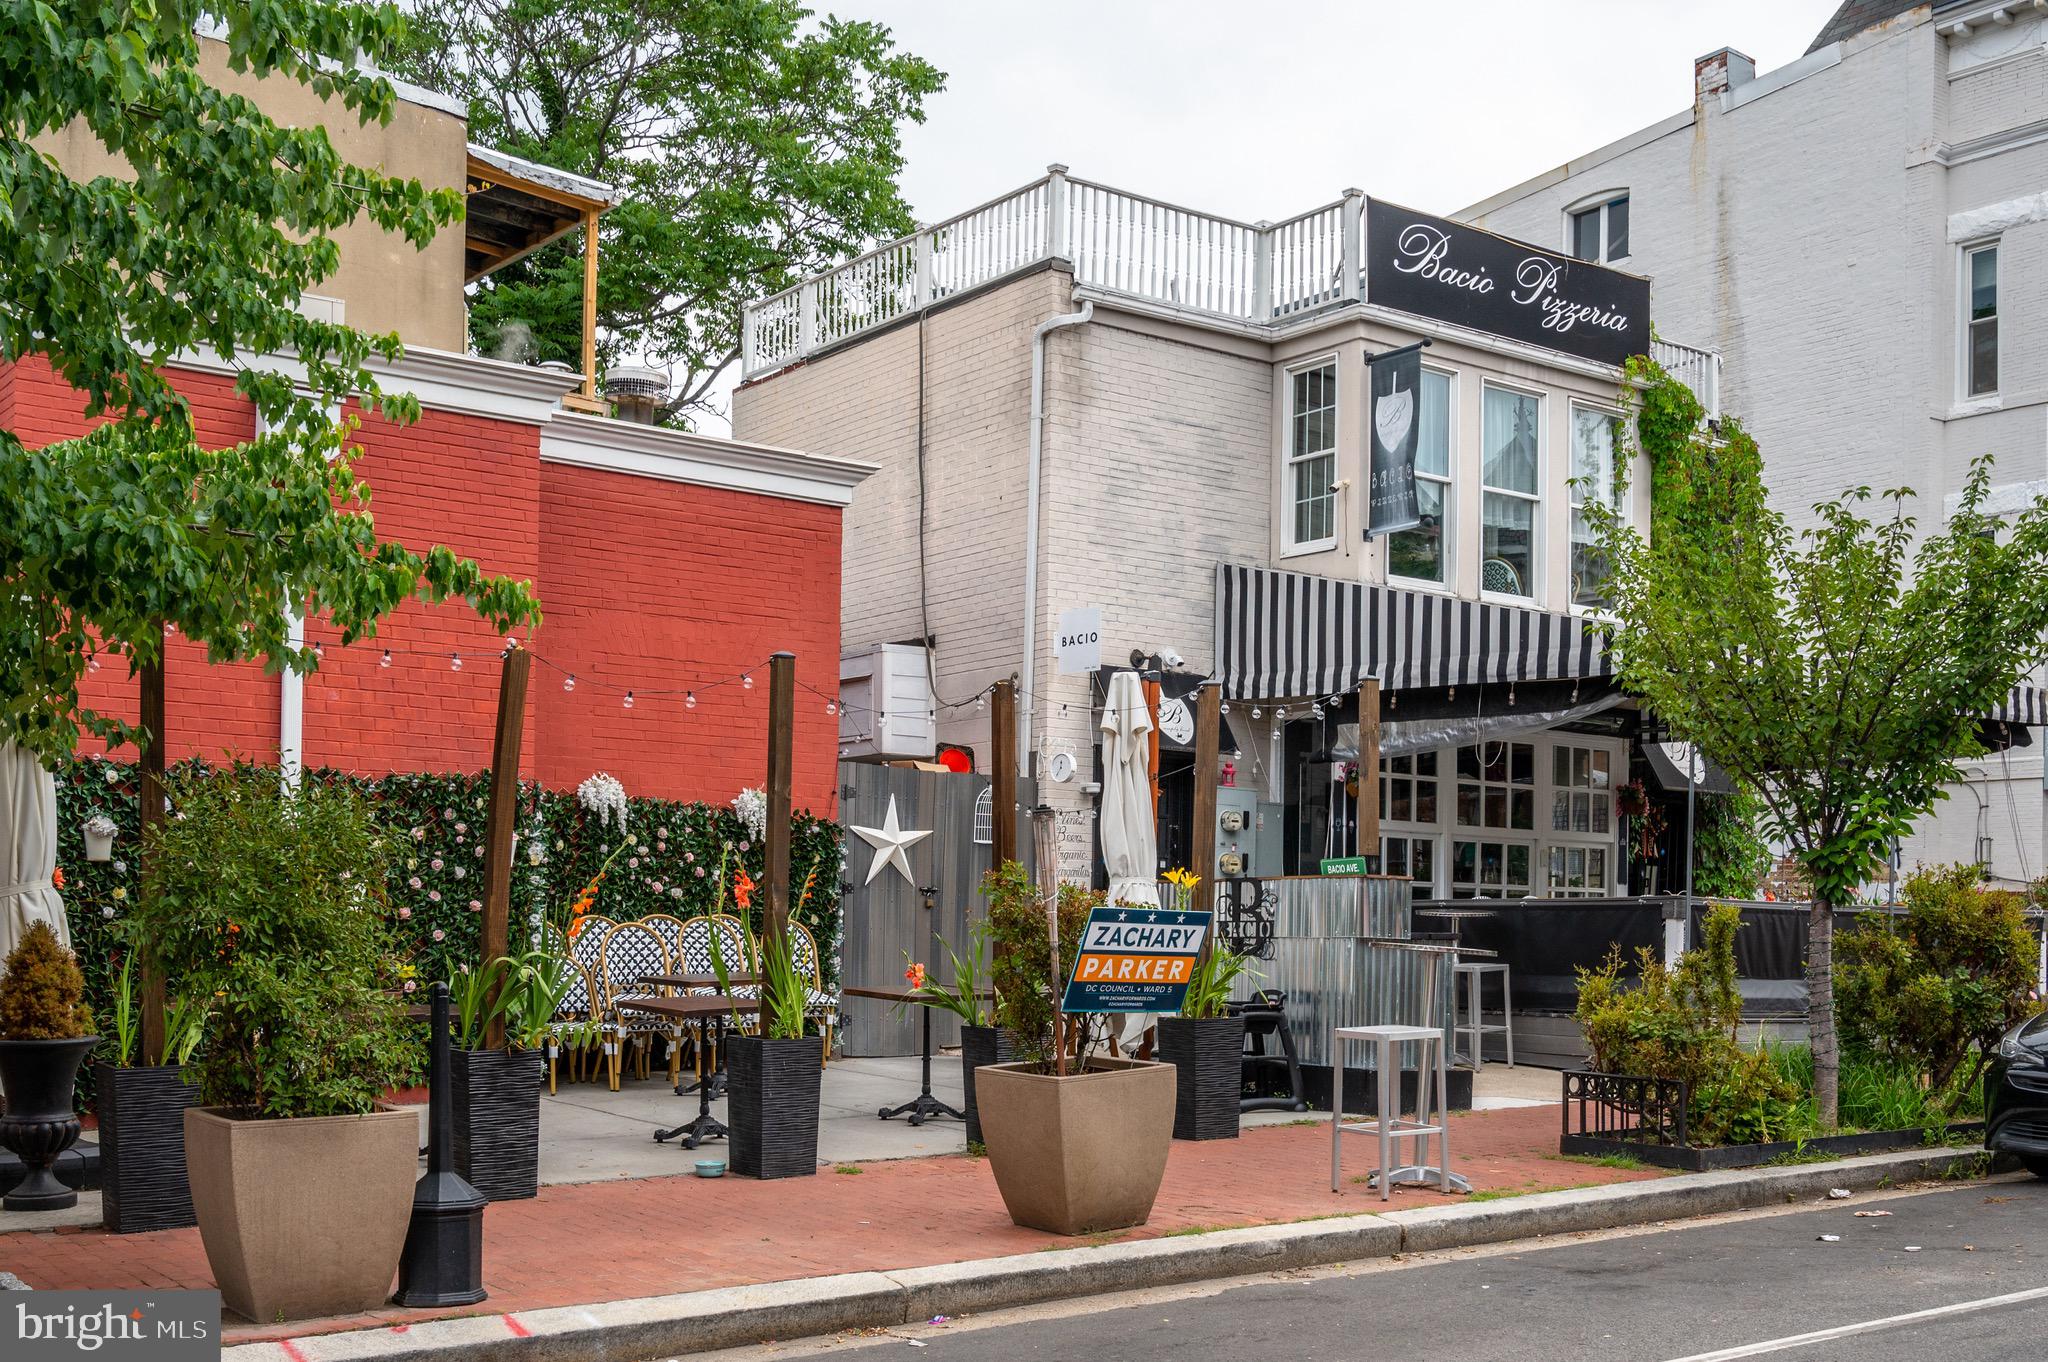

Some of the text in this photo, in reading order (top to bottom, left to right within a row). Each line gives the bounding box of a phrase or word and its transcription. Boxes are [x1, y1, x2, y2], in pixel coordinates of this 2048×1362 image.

[1394, 223, 1628, 333] Bacio Pizzeria
[1061, 631, 1098, 648] BACIO
[1327, 863, 1360, 874] BACIO AVE.
[1093, 926, 1197, 949] ZACHARY
[1082, 957, 1185, 980] PARKER
[1085, 984, 1098, 992] DC
[1100, 984, 1135, 993] COUNCIL
[1143, 985, 1167, 993] WARD
